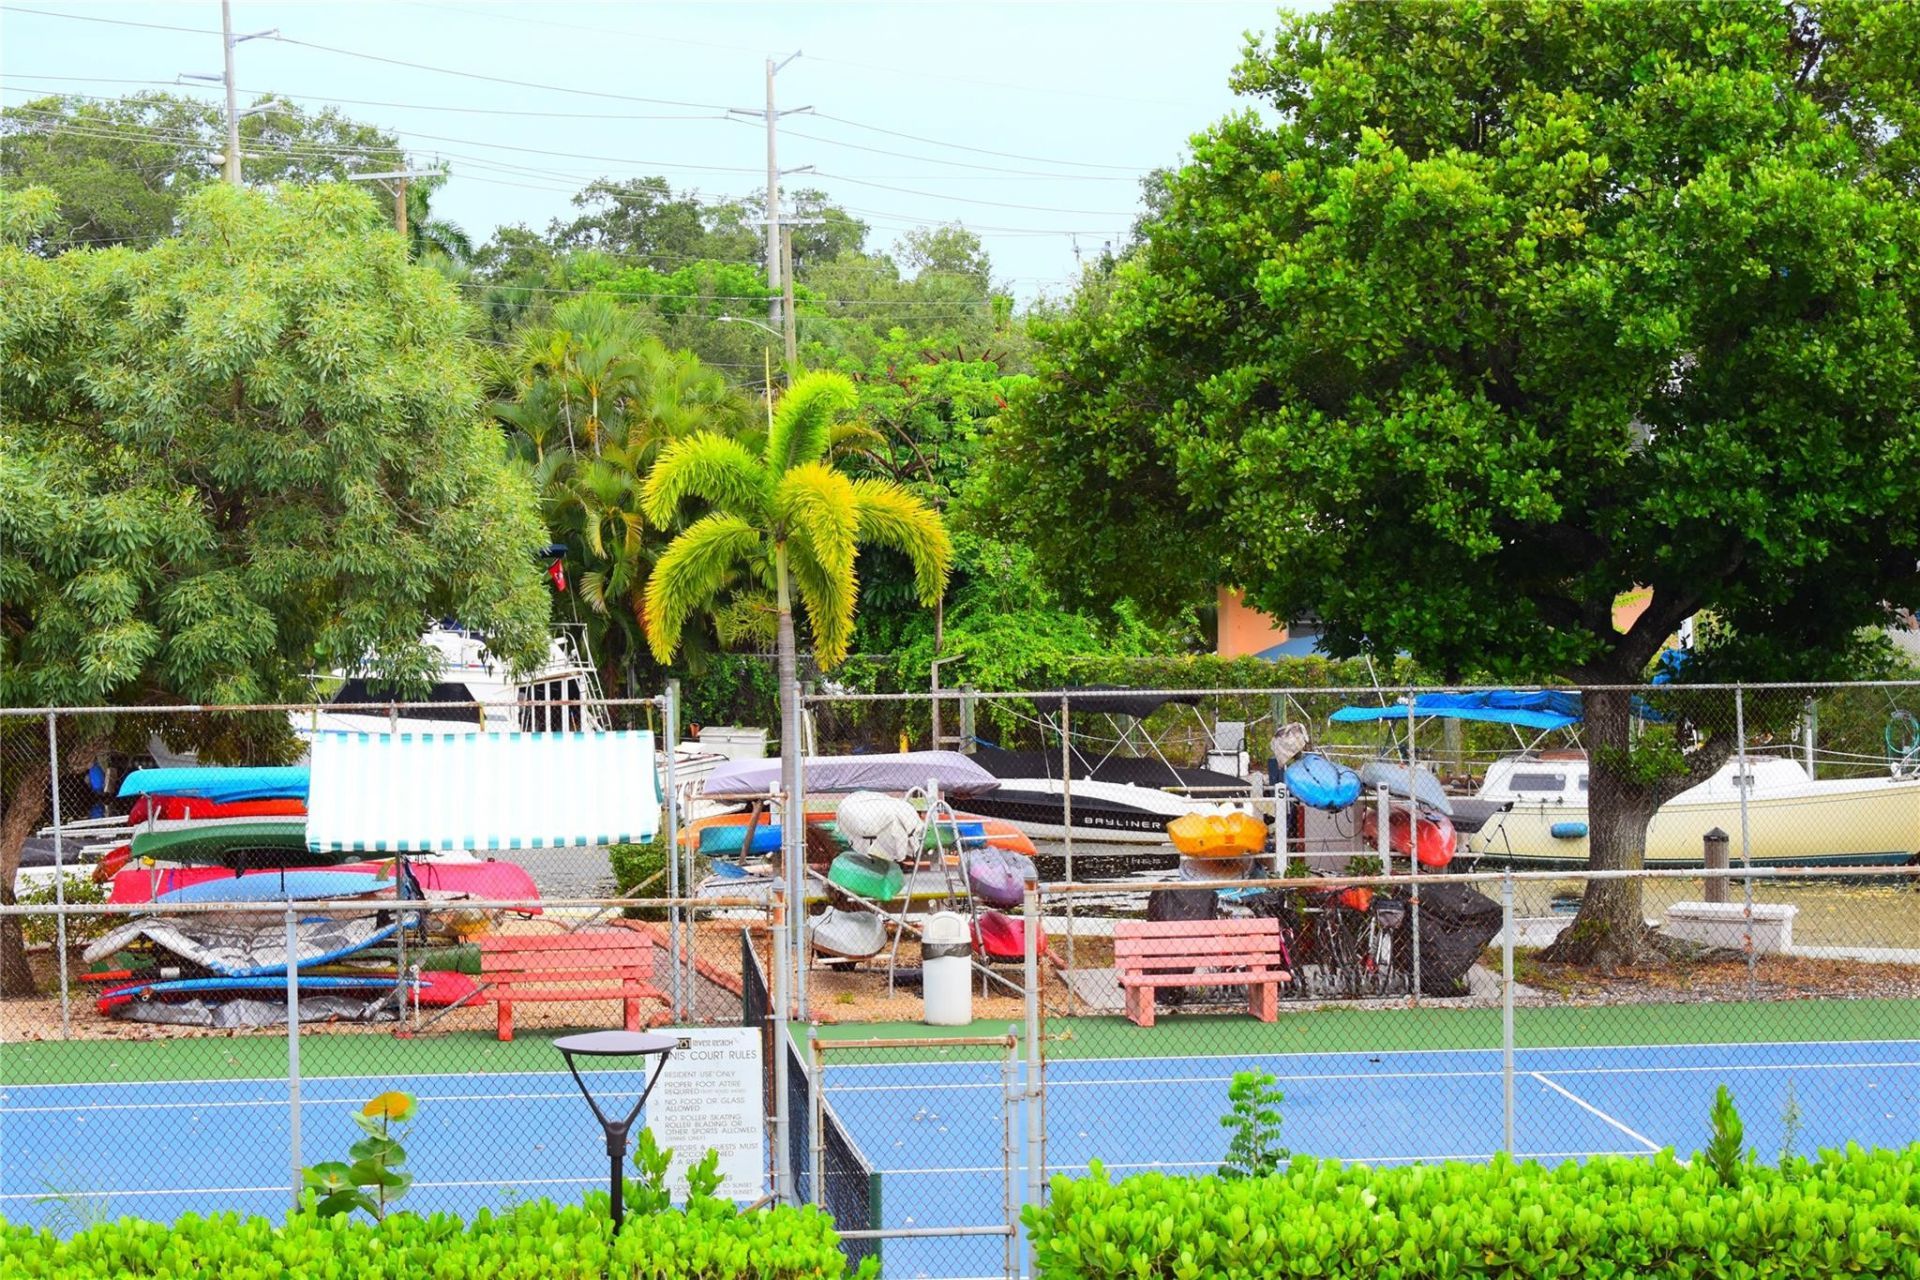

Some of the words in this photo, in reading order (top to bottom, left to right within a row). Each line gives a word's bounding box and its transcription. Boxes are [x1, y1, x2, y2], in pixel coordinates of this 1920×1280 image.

[1084, 816, 1161, 829] BAYLINER
[653, 1051, 686, 1061] TENIS
[689, 1051, 724, 1060] COURT
[729, 1050, 757, 1059] RULES
